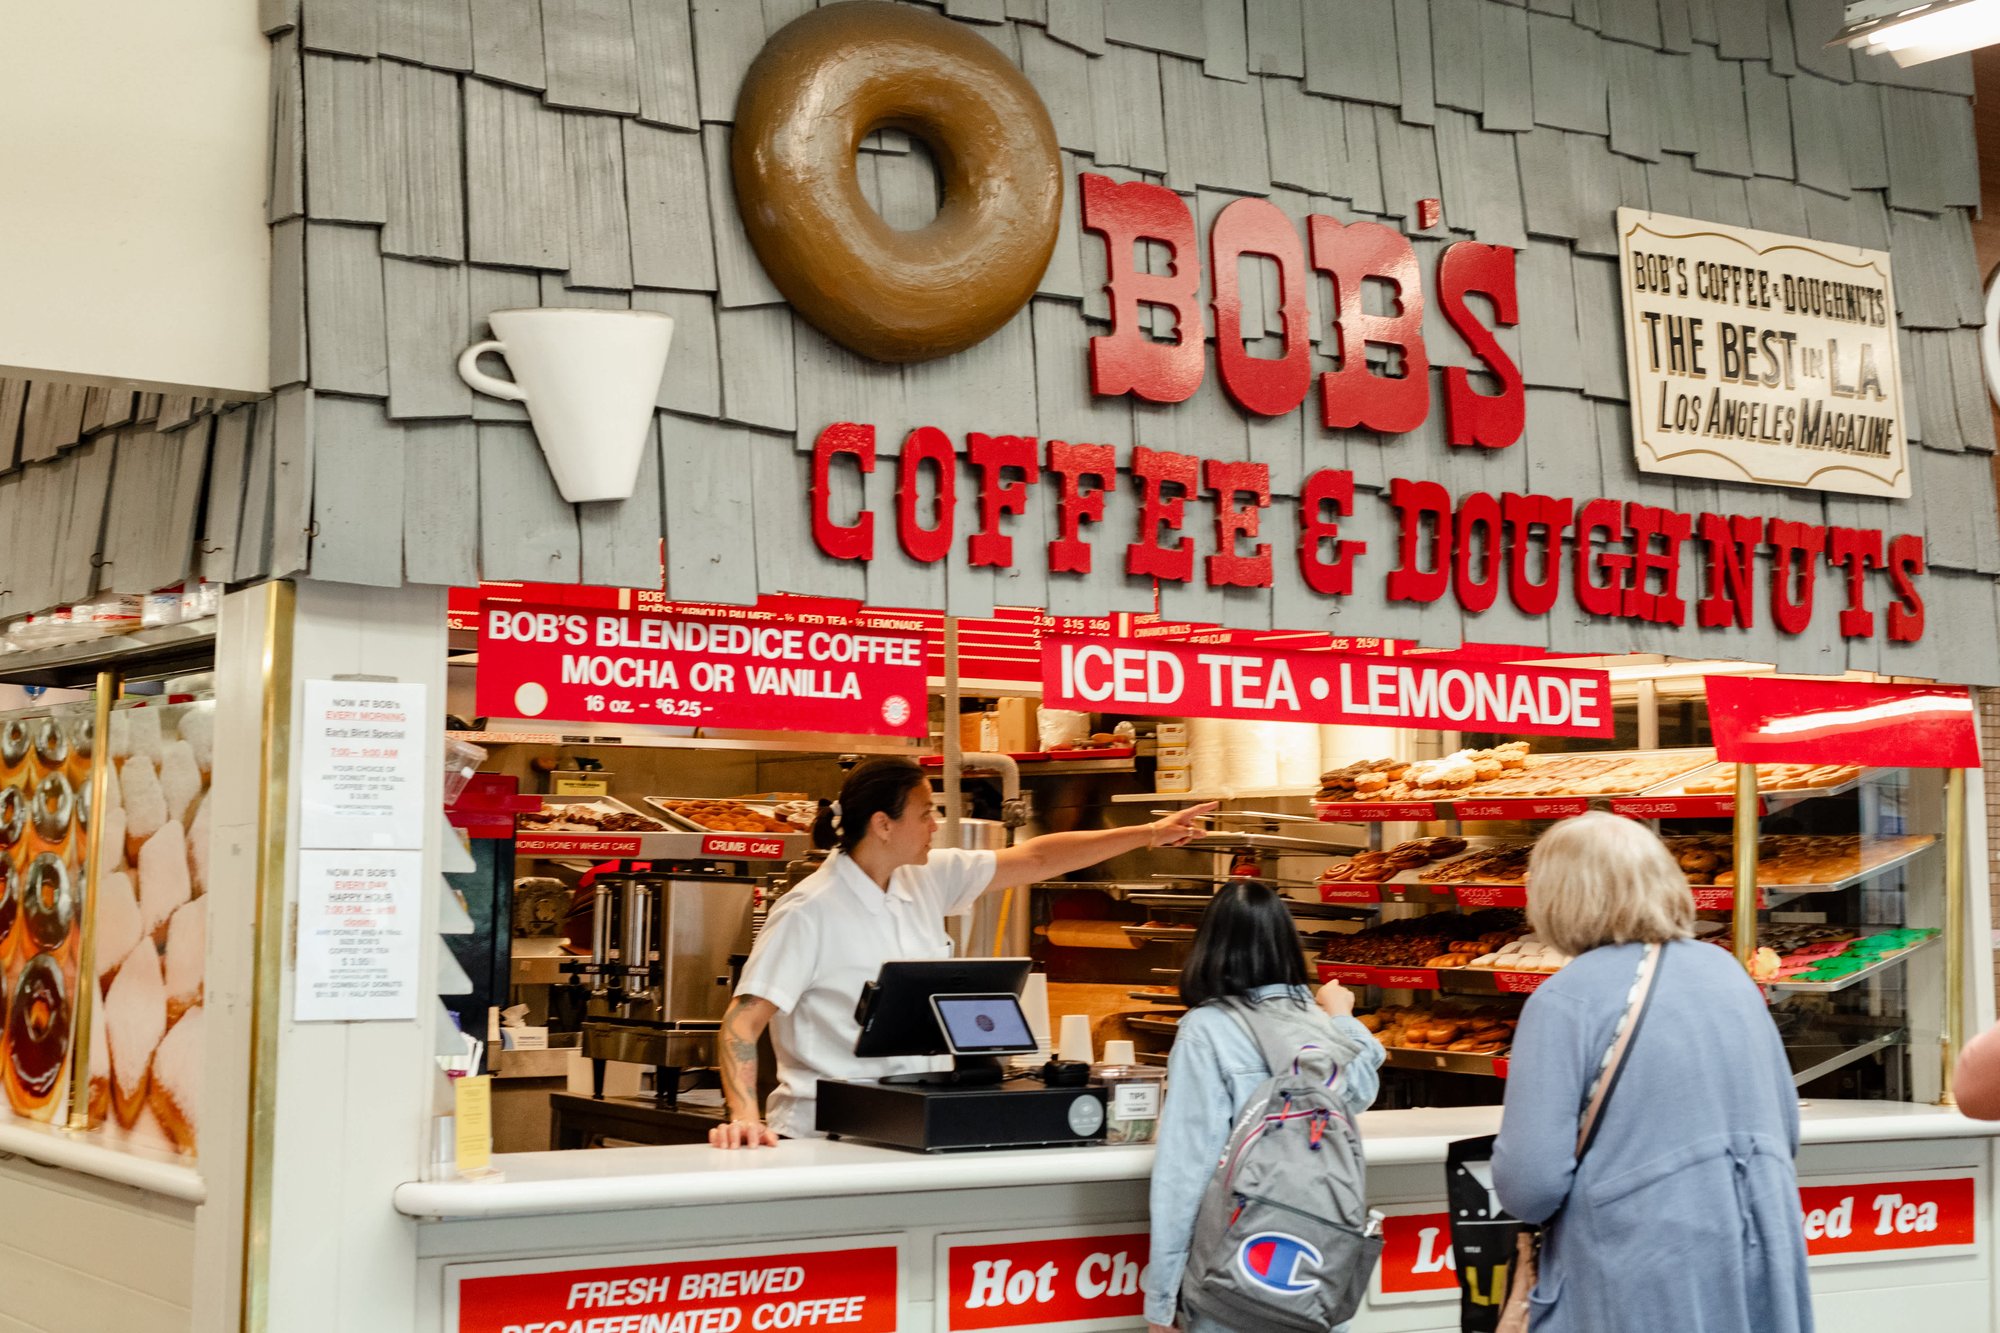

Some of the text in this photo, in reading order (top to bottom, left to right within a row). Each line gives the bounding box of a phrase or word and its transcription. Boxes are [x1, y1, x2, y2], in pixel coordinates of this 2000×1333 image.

[1079, 172, 1525, 449] BOB'S
[1634, 250, 1688, 297] BOB'S
[1696, 260, 1771, 311] COFFEE
[1782, 272, 1887, 327] DOUGHNUTS
[1641, 311, 1707, 380] THE
[1717, 320, 1798, 390] BEST
[1796, 397, 1895, 458] MAGAZINE
[811, 421, 1926, 643] COFFEE & DOUGHNUTS
[488, 610, 588, 646] BOB'S
[808, 632, 922, 667] COFFEE
[826, 615, 847, 626] TEA
[867, 618, 924, 632] LEMONADE
[1033, 616, 1111, 631] 2.90 3.15 3.60
[562, 654, 862, 701] MOCHA OR VANILLA
[1060, 643, 1602, 729] ICED TEA LEMONADE
[326, 710, 406, 722] EVERY MORNING
[584, 695, 605, 712] 16
[609, 700, 635, 713] oz.
[326, 728, 348, 738] Early
[372, 729, 405, 739] Special
[546, 841, 579, 850] HONEY
[580, 842, 610, 850] WHEAT
[611, 842, 636, 851] CAKE
[709, 839, 780, 854] CRUMB CAKE
[328, 893, 360, 902] HAPPY
[335, 881, 365, 890] EVERY
[1801, 1193, 1938, 1241] ed Tea
[566, 1266, 805, 1310] FRESH BREWED
[964, 1258, 1058, 1310] Hot
[751, 1296, 866, 1327] COFFEE
